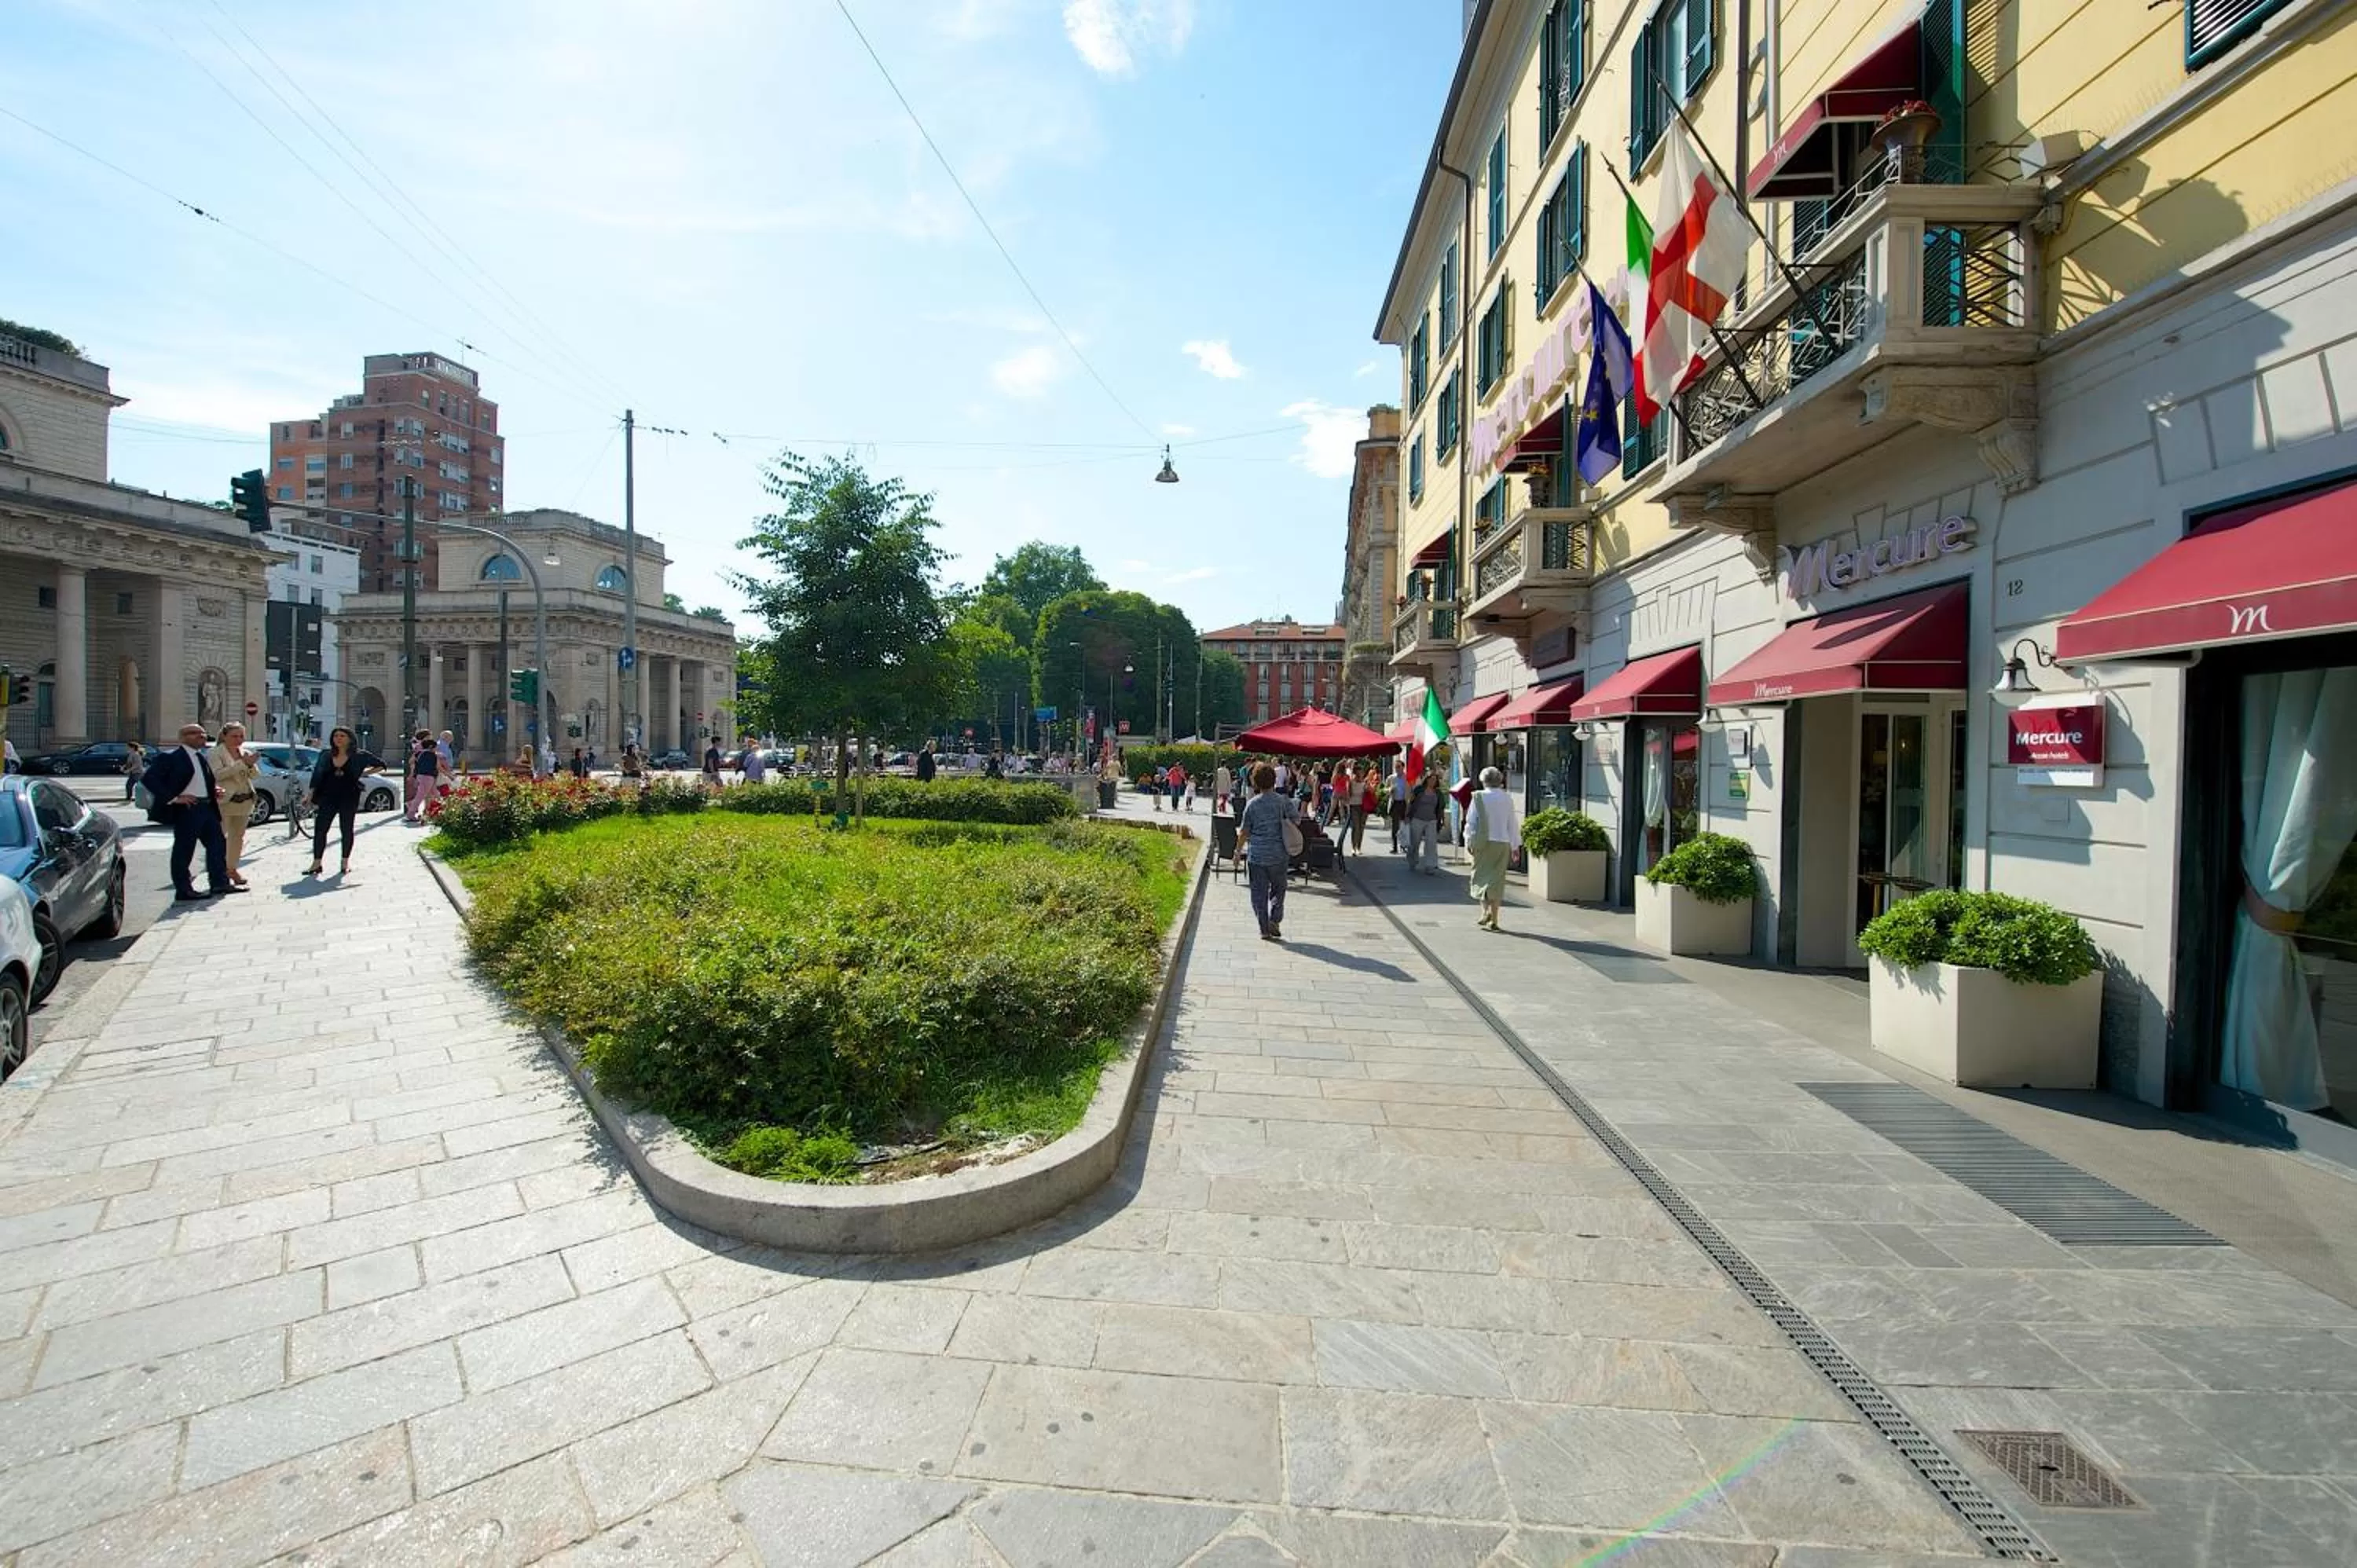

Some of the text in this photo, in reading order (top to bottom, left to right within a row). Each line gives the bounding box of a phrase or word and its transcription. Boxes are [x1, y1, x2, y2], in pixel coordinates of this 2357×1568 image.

[1776, 515, 1973, 597] Mercure
[2009, 578, 2023, 596] 12
[1754, 681, 1793, 698] Mercure
[2016, 731, 2083, 745] Mercure
